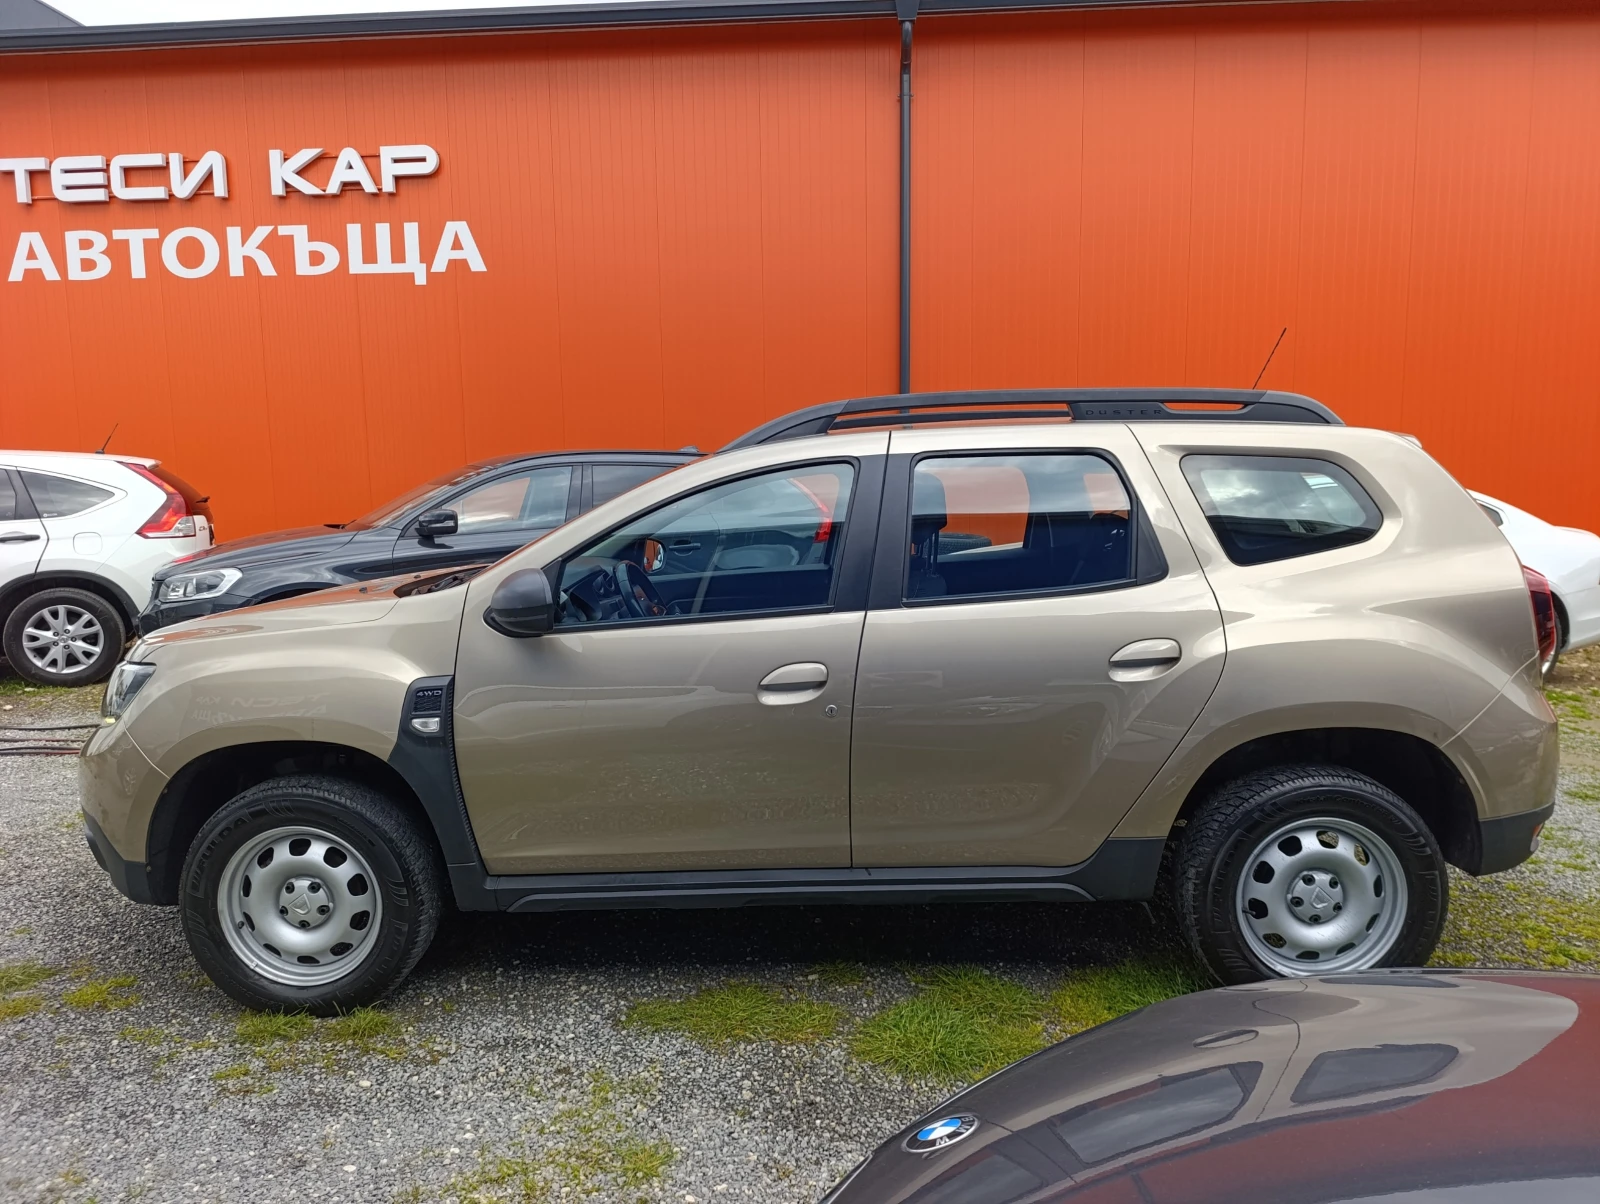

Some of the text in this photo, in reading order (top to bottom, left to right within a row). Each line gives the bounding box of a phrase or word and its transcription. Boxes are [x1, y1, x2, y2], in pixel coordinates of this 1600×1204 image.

[0, 144, 440, 204] ТЕСИ КАР
[8, 220, 488, 286] АВТОКЪЩА
[935, 1116, 974, 1147] BMW
